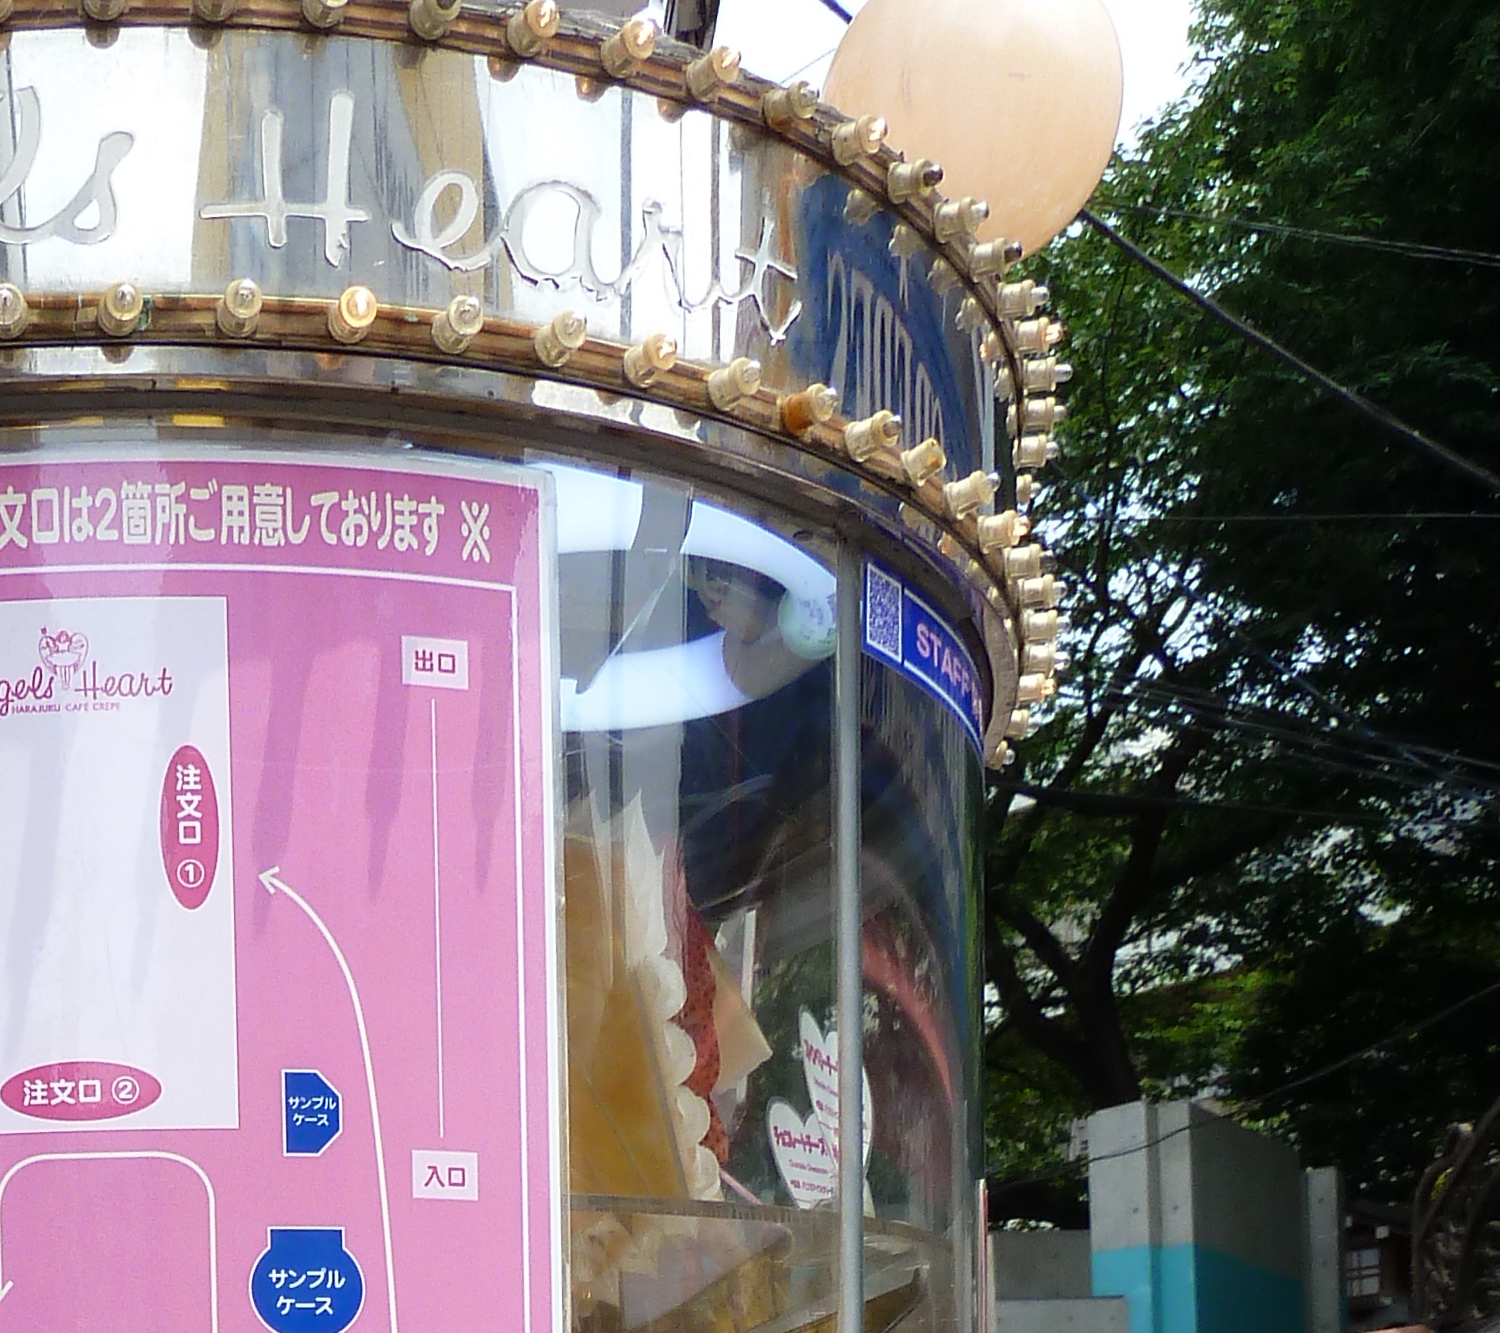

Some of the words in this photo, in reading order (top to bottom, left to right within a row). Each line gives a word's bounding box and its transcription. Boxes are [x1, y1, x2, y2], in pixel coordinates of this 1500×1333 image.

[200, 90, 804, 342] Heart
[412, 647, 458, 676] 出口
[74, 660, 174, 701] Heart
[11, 703, 61, 715] HARAJUKU
[175, 763, 202, 847] 注文口
[21, 1077, 103, 1108] 注文口
[287, 1093, 338, 1114] サンプル
[291, 1111, 331, 1129] ケース
[423, 1164, 467, 1190] 入口
[267, 1266, 346, 1292] サンプル
[276, 1294, 335, 1318] ケース
